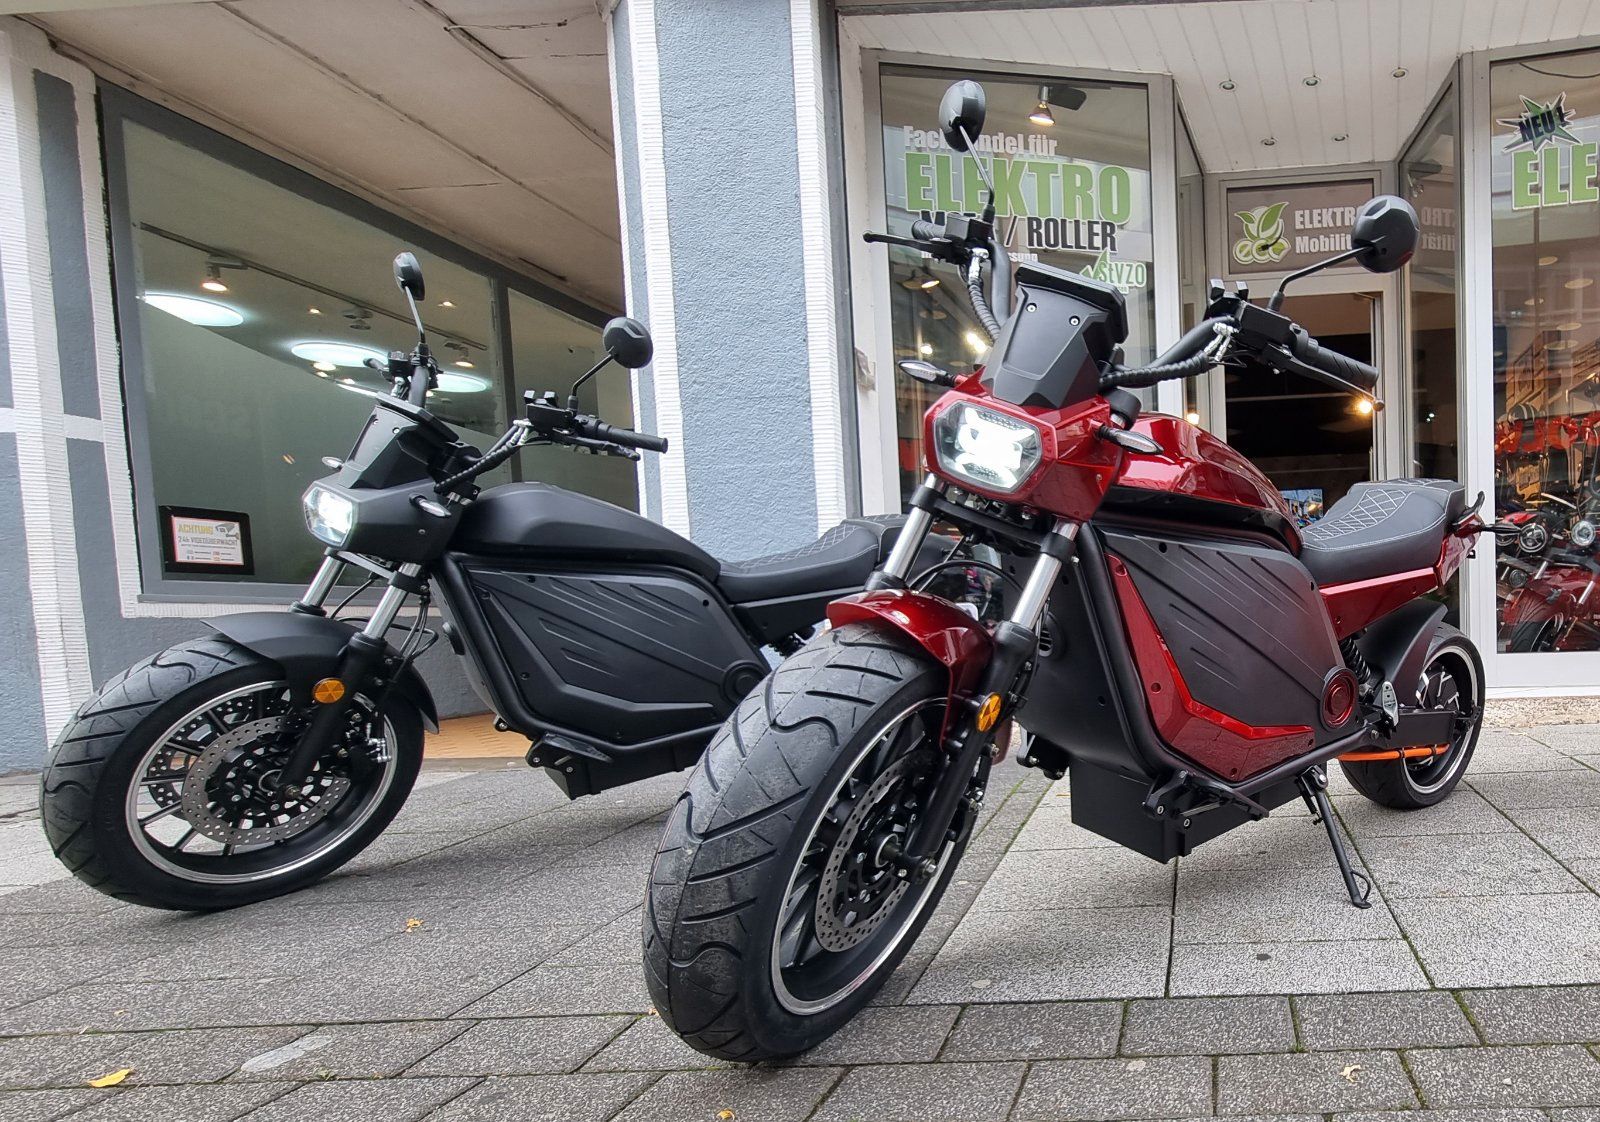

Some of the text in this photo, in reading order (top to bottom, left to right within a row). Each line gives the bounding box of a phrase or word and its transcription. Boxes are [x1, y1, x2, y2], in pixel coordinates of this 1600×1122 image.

[1028, 133, 1058, 157] für
[904, 151, 1132, 226] ELEKTRO
[1295, 206, 1361, 229] ELEKTR
[1027, 217, 1117, 252] ROLLER
[1295, 233, 1353, 254] Mobilit
[1098, 261, 1146, 286] StVZO
